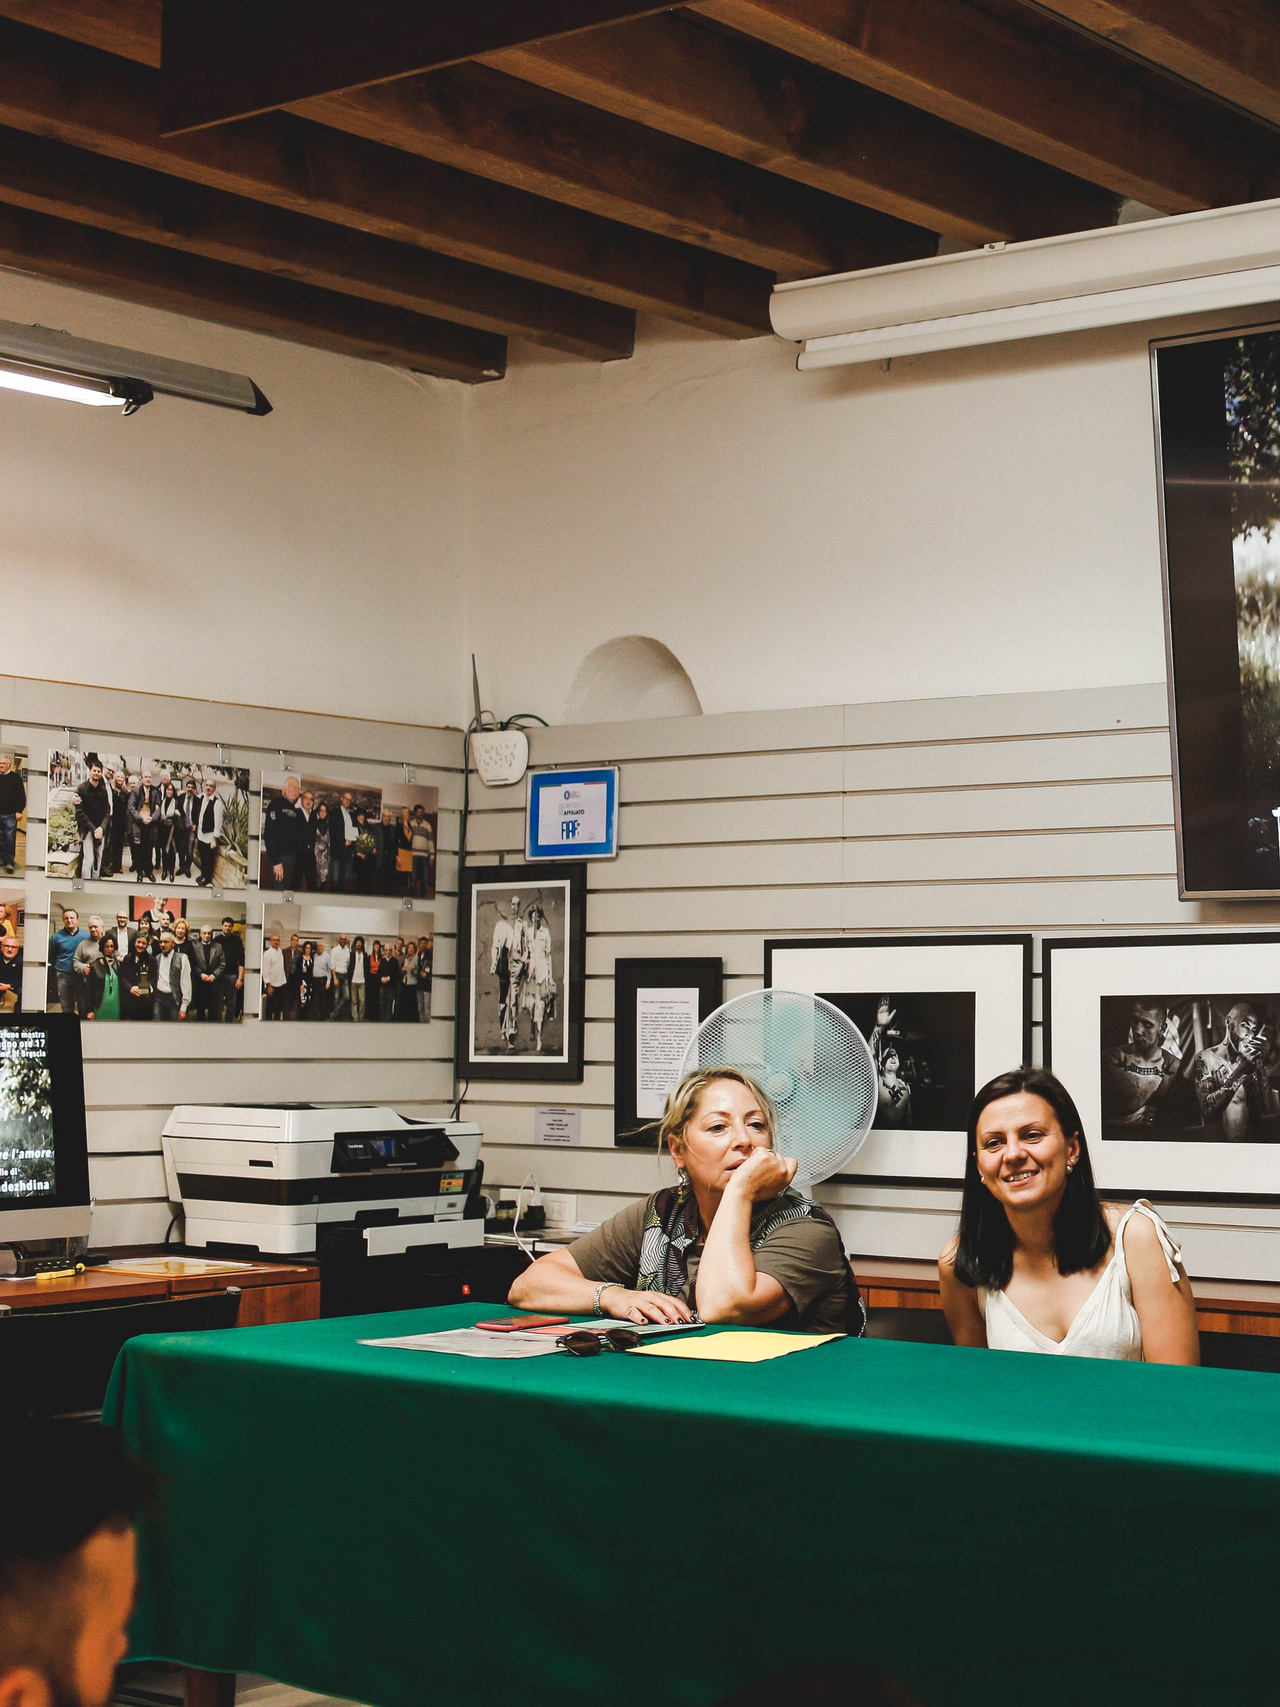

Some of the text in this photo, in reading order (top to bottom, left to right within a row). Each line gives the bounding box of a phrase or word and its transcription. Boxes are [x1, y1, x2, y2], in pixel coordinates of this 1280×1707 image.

[20, 1031, 46, 1039] mostra
[34, 1039, 46, 1048] 17
[20, 1049, 47, 1059] Brescia
[11, 1148, 52, 1160] l'amore
[10, 1167, 18, 1176] di
[0, 1179, 50, 1192] dezhdina
